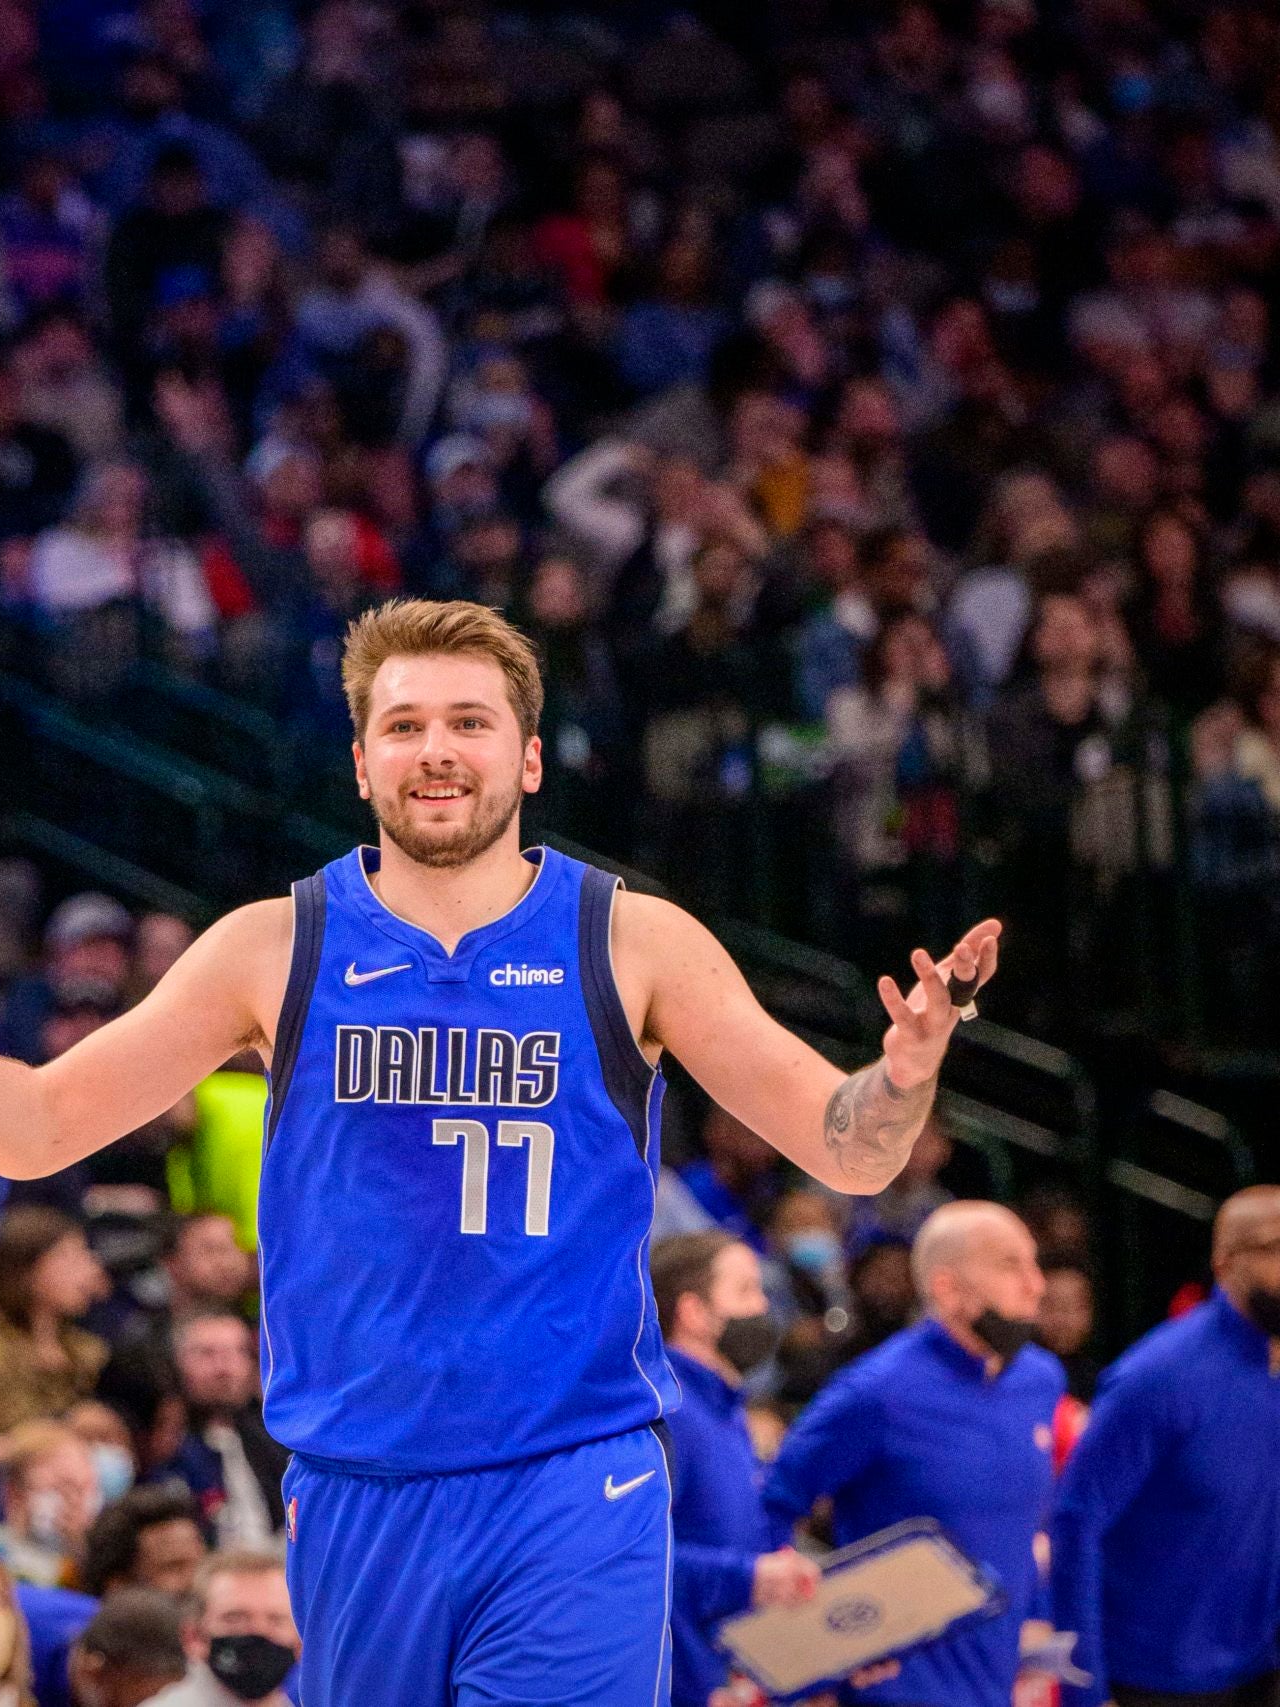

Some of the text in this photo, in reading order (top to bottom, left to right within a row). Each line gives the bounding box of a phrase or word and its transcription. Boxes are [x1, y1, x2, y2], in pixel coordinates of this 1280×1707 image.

[490, 963, 564, 986] chime
[335, 1025, 560, 1108] DALLAS
[432, 1119, 554, 1236] 77
